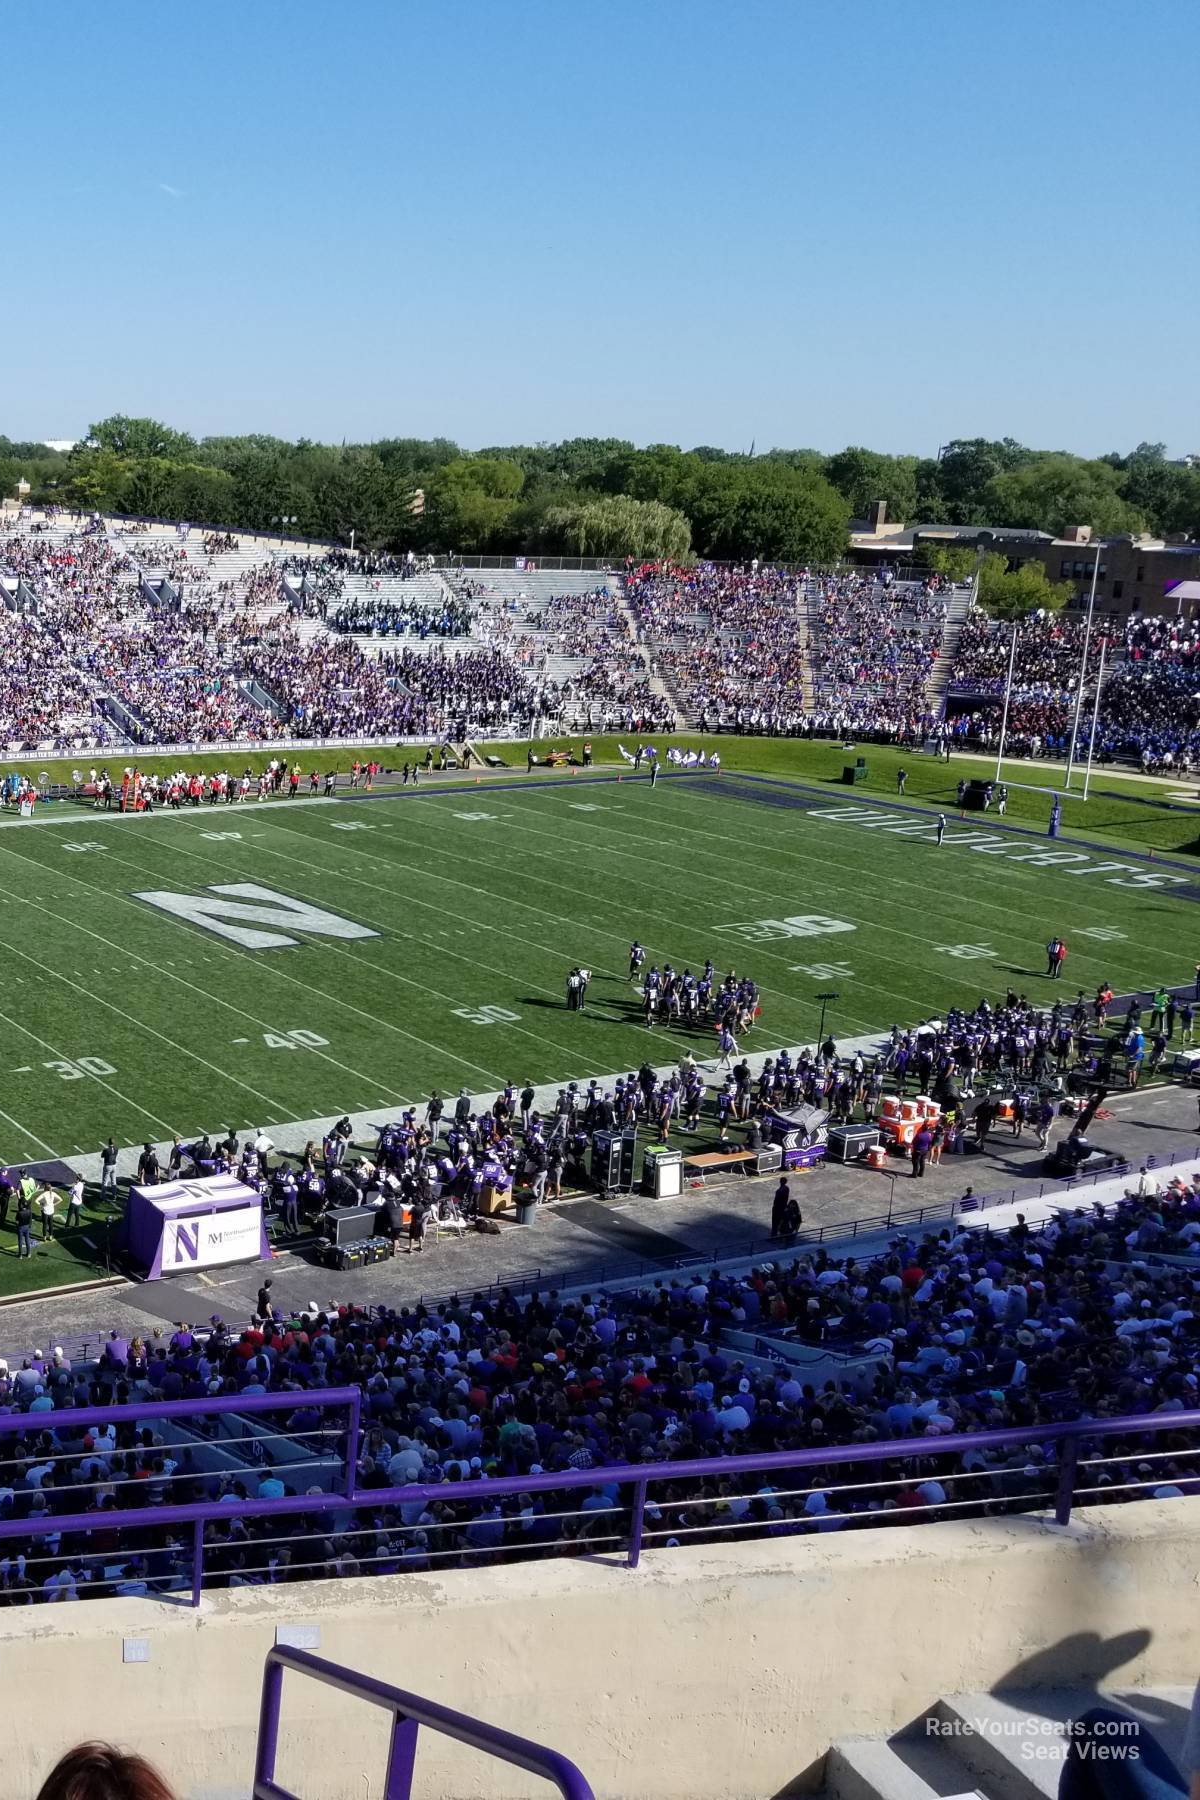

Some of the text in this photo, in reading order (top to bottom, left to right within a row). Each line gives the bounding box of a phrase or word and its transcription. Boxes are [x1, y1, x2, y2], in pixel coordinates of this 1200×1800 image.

[807, 806, 1191, 889] WILDCATS
[130, 882, 383, 949] N
[787, 963, 856, 980] 30
[450, 1004, 523, 1025] 50
[263, 1028, 330, 1050] 40
[42, 1056, 118, 1080] 30
[175, 1222, 199, 1262] N
[135, 1357, 141, 1367] 2
